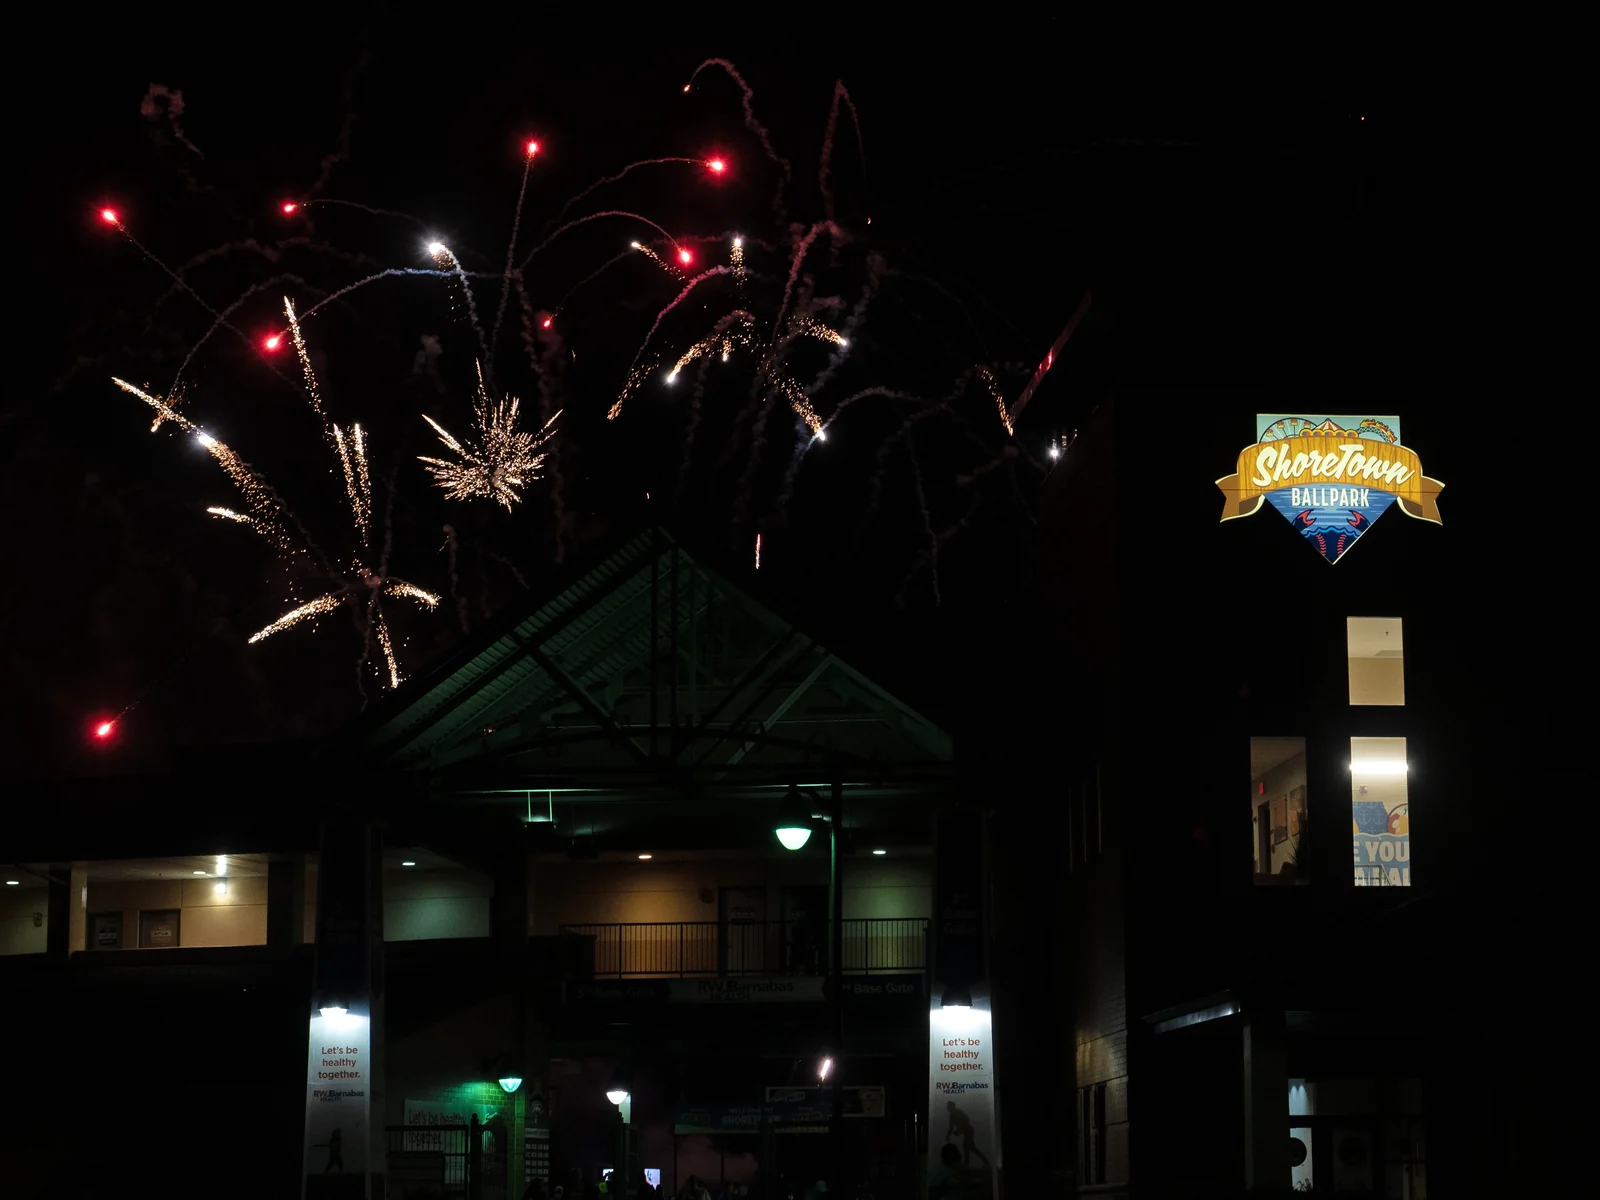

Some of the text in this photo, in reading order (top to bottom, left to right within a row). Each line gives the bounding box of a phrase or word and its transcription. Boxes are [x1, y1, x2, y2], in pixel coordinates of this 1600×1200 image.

[1252, 443, 1415, 487] ShoreTown
[1291, 488, 1369, 507] BALLPARK
[1365, 841, 1410, 862] YOU
[854, 982, 882, 994] Base
[885, 982, 915, 994] Gate
[943, 1038, 981, 1047] Let's be
[321, 1046, 358, 1055] Let's be
[944, 1050, 980, 1060] healthy
[322, 1058, 357, 1067] healthy
[940, 1062, 984, 1073] together.
[318, 1070, 361, 1080] together.
[936, 1081, 989, 1090] RWJBarnabas
[408, 1109, 427, 1124] Let's
